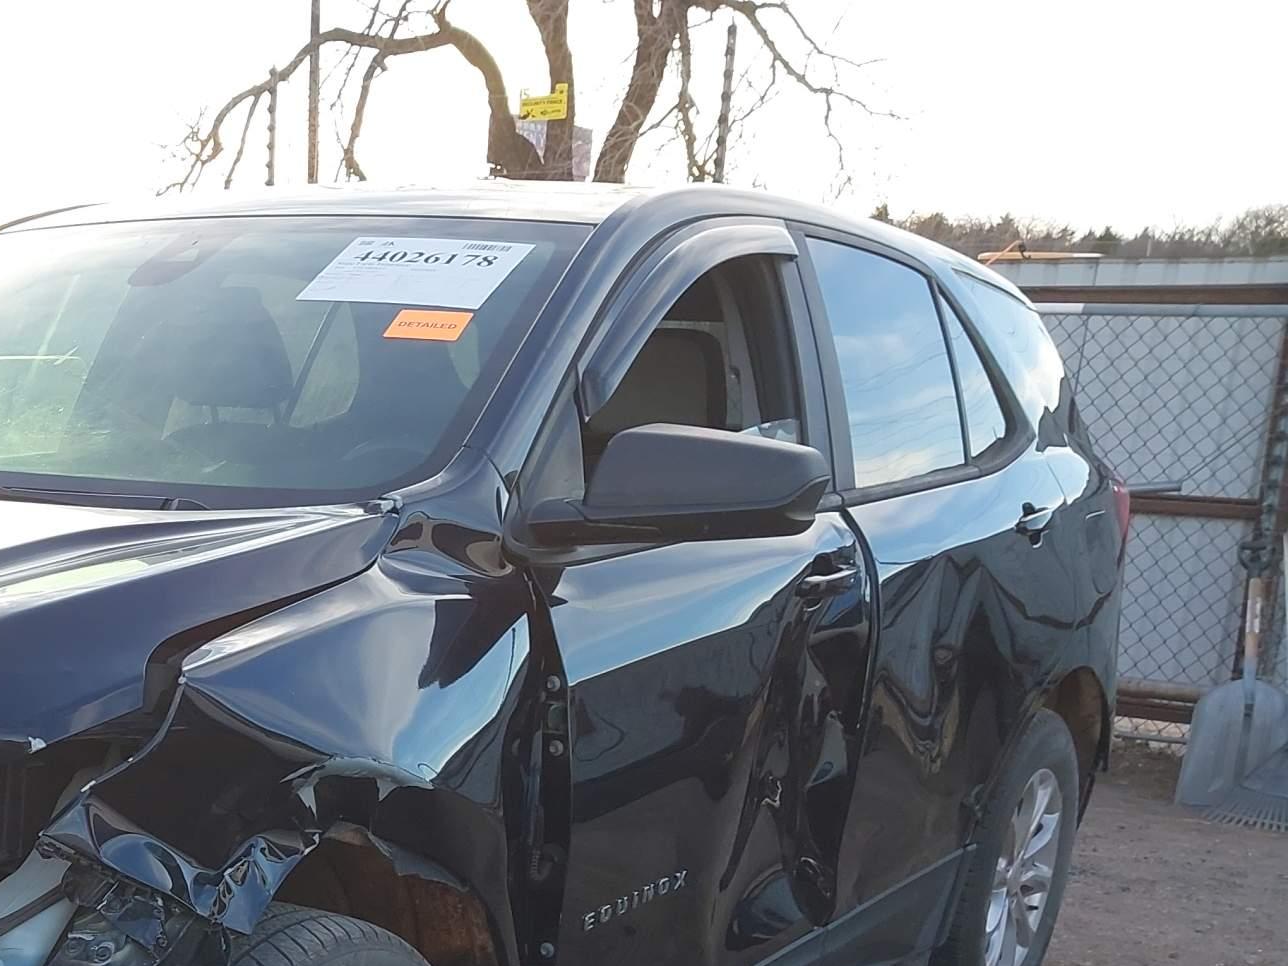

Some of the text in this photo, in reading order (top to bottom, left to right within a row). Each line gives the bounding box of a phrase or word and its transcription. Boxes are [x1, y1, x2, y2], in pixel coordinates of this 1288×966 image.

[354, 250, 498, 268] 44026178
[398, 320, 457, 330] DETAILED
[583, 870, 688, 931] EQUINOX
